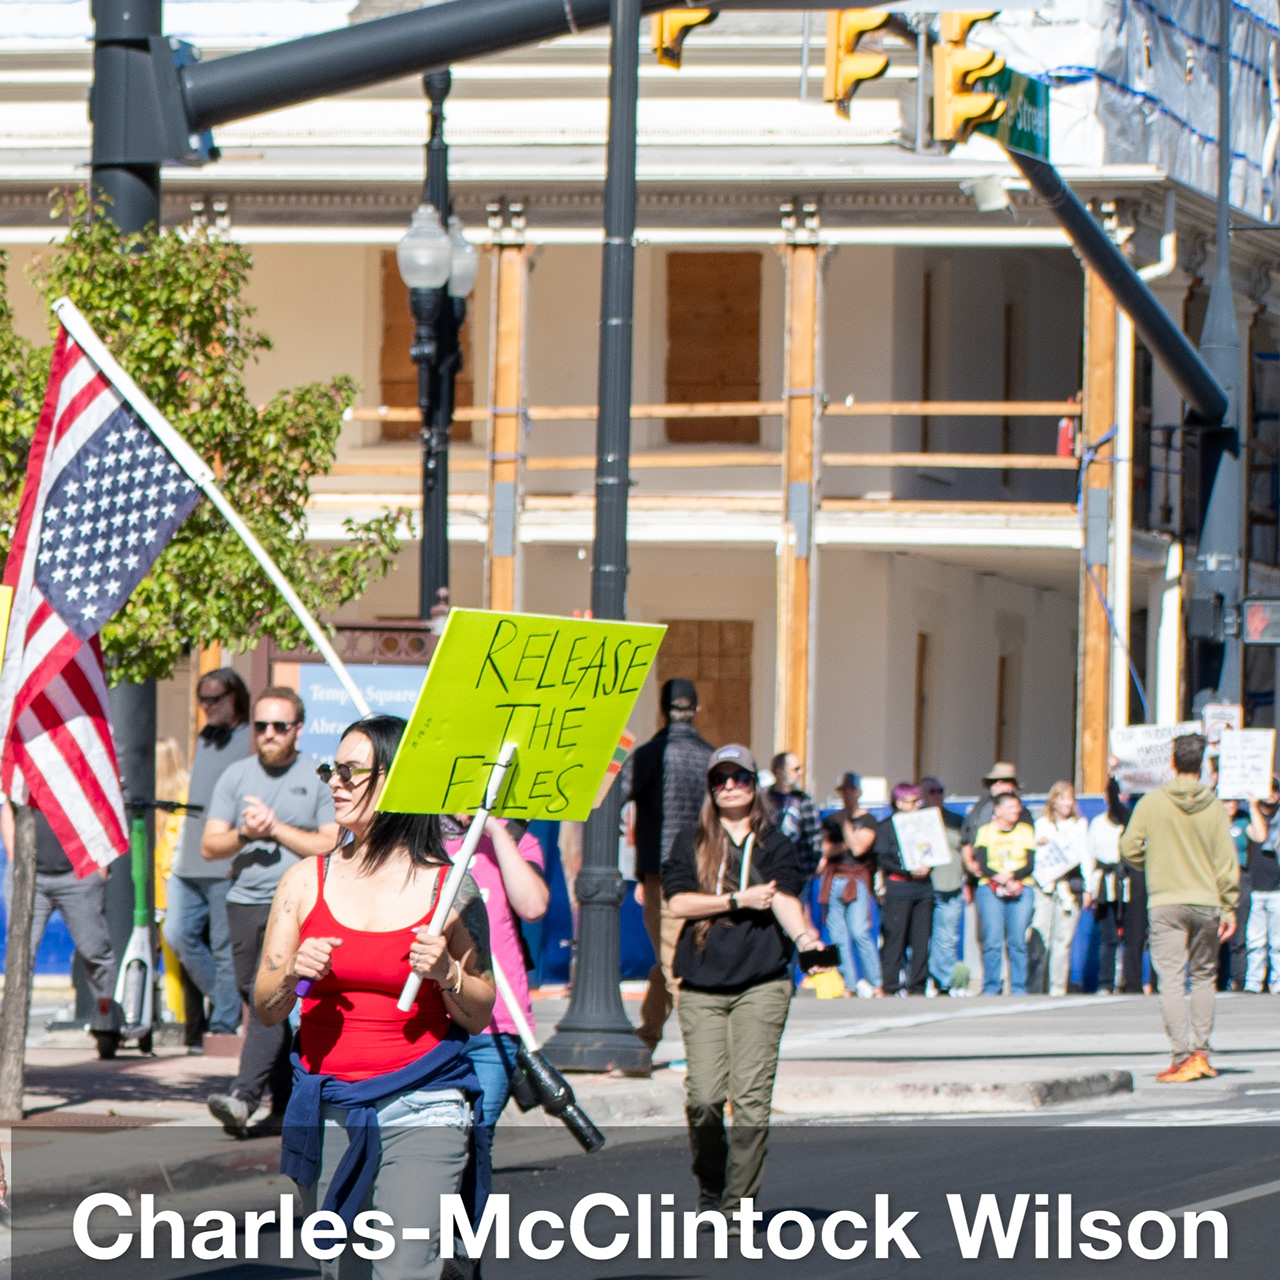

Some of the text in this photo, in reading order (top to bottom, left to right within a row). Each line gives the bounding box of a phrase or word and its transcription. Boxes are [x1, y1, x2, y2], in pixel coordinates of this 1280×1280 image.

[476, 619, 652, 699] RELEASE
[365, 685, 418, 706] Square
[495, 703, 586, 752] THE
[441, 756, 584, 814] FILES
